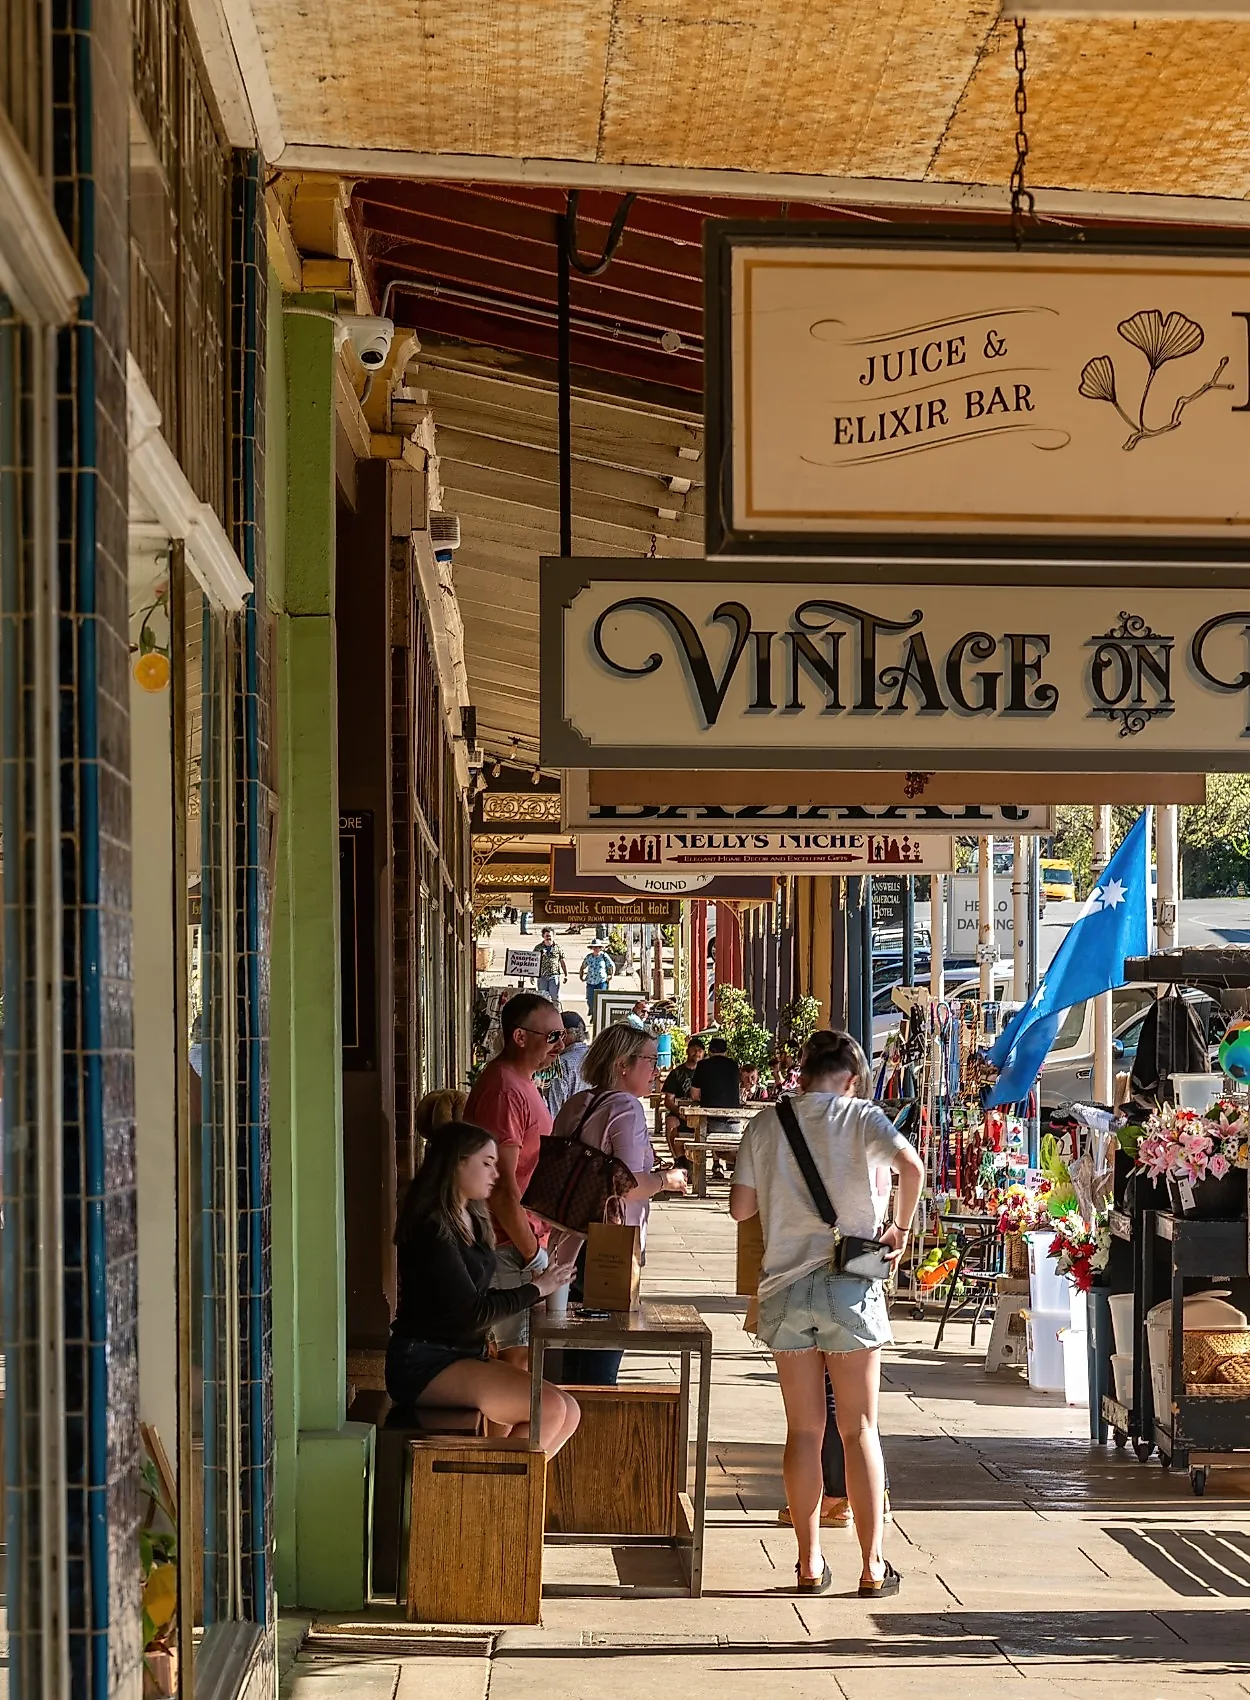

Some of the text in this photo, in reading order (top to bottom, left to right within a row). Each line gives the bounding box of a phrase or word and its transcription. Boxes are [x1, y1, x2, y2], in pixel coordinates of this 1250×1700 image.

[858, 330, 1009, 387] JUICE &
[833, 384, 1036, 446] ELIXIR BAR
[594, 597, 1060, 731] VINTAGE
[1090, 634, 1176, 714] ON
[339, 816, 363, 829] ORE
[645, 879, 687, 891] HOUND
[872, 882, 901, 891] ANSWELLS
[544, 901, 670, 915] Tanswells Commercial Hotel
[964, 900, 1008, 912] HEO
